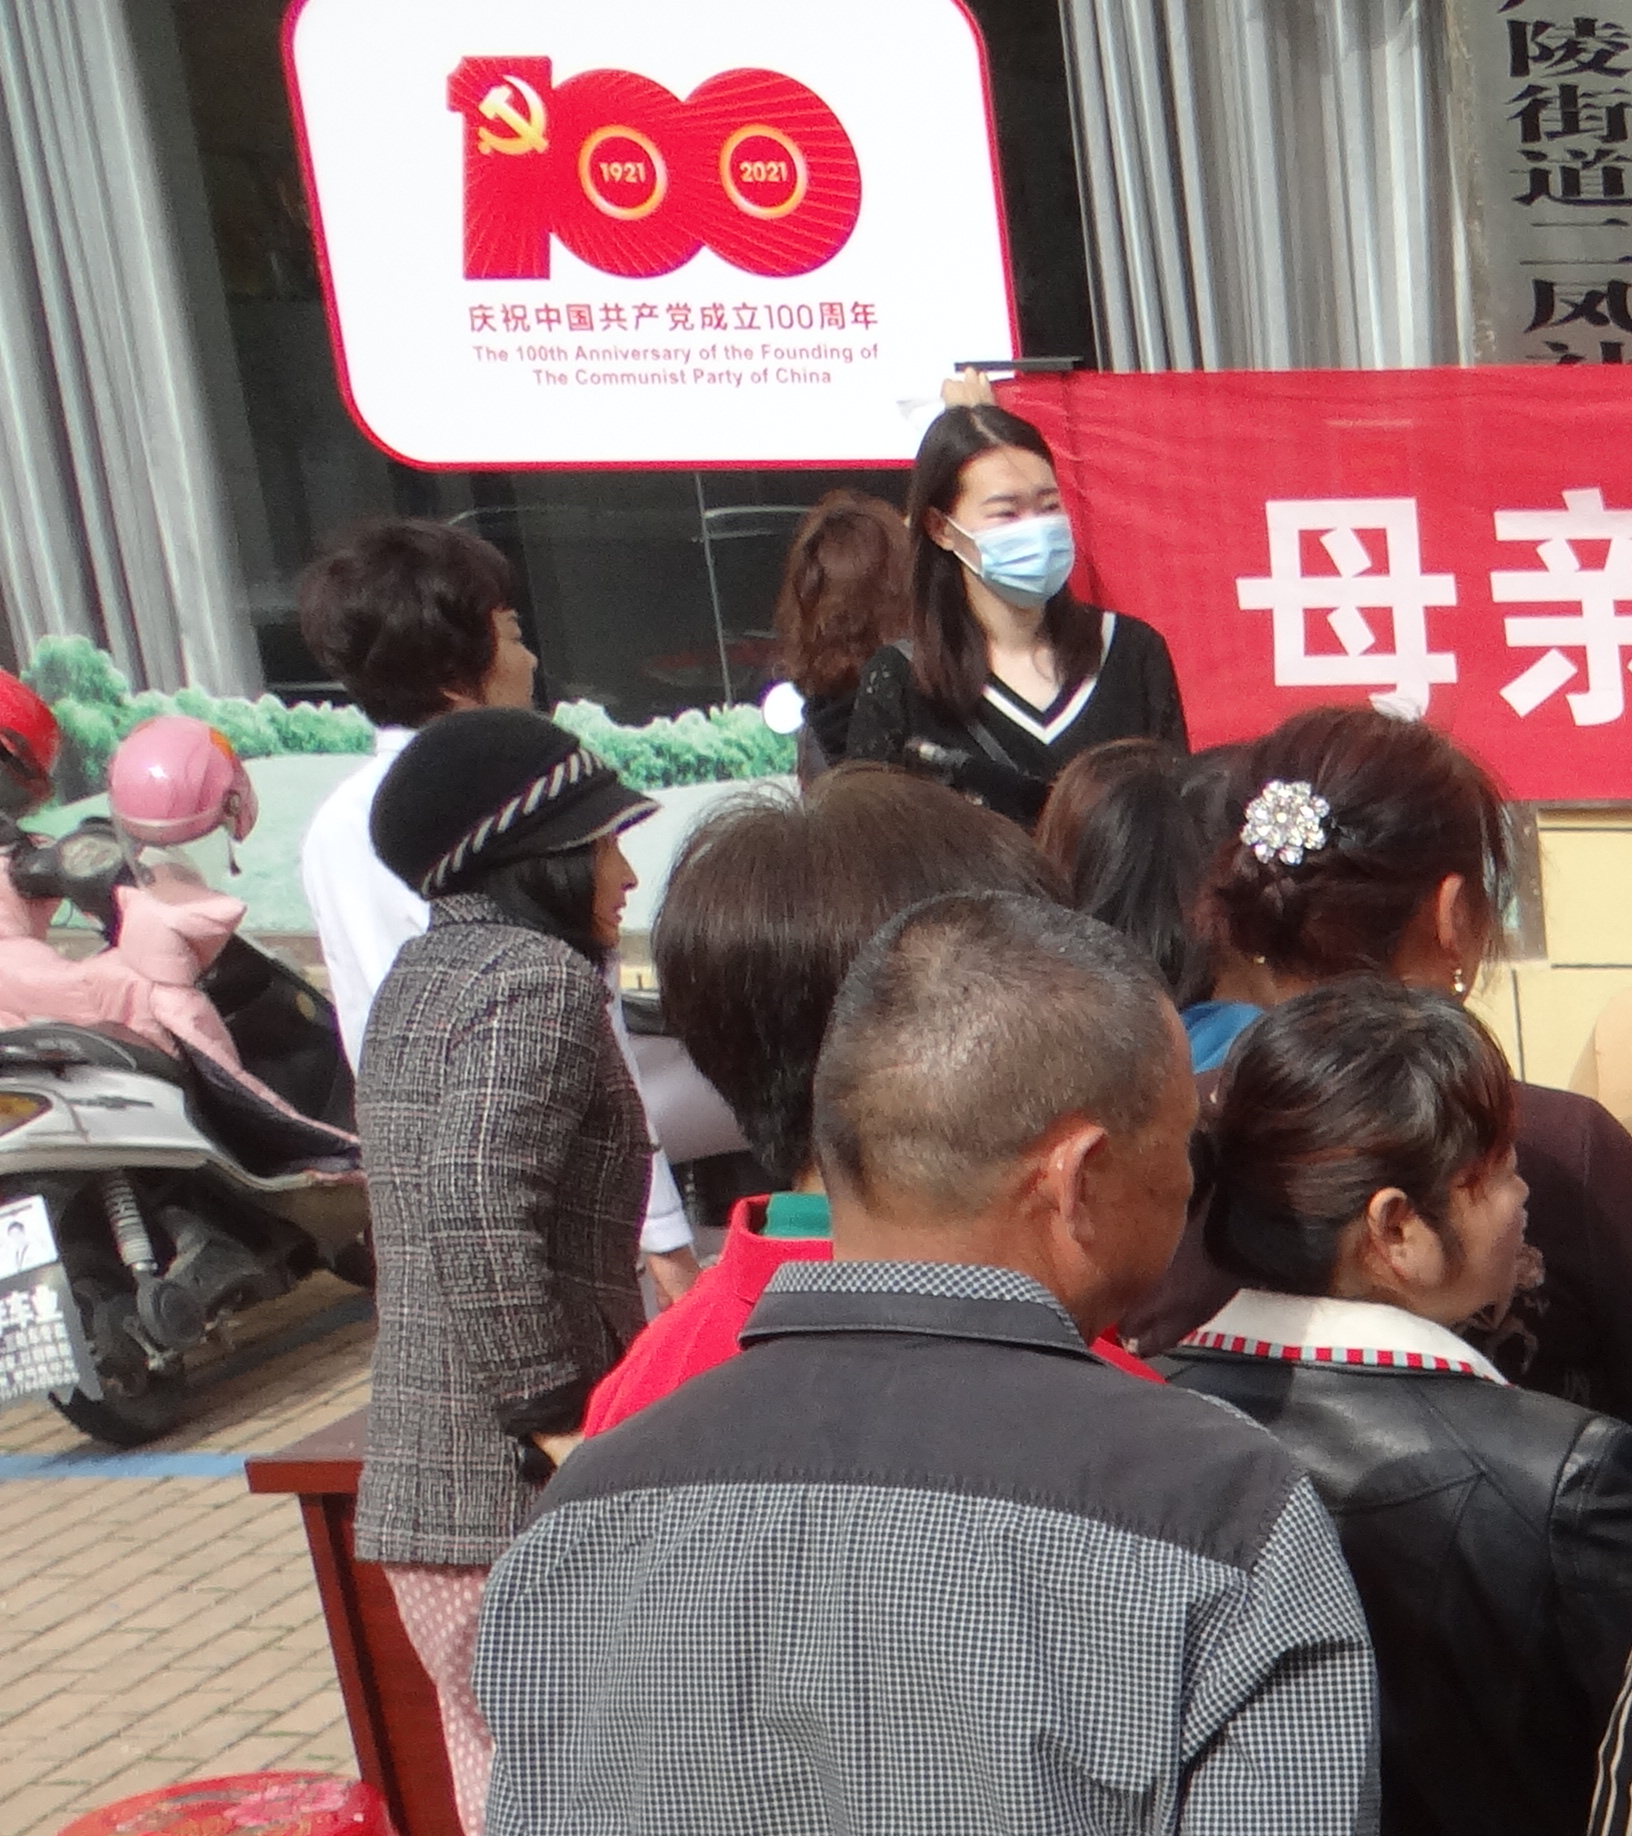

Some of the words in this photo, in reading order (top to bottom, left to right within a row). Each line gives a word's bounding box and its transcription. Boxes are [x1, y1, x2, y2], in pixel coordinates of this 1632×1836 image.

[600, 161, 646, 183] 1921
[740, 161, 788, 183] 2021
[469, 301, 879, 332] 庆祝中国共产党成立100周年
[473, 346, 508, 362] The
[516, 345, 568, 362] 100th
[575, 345, 691, 364] Anniversary
[699, 344, 719, 361] of
[724, 345, 754, 361] the
[761, 344, 853, 363] Founding
[860, 343, 879, 360] of
[532, 369, 568, 385] The
[575, 369, 686, 386] Communist
[693, 369, 743, 387] Party
[750, 368, 769, 384] of
[776, 367, 832, 384] China
